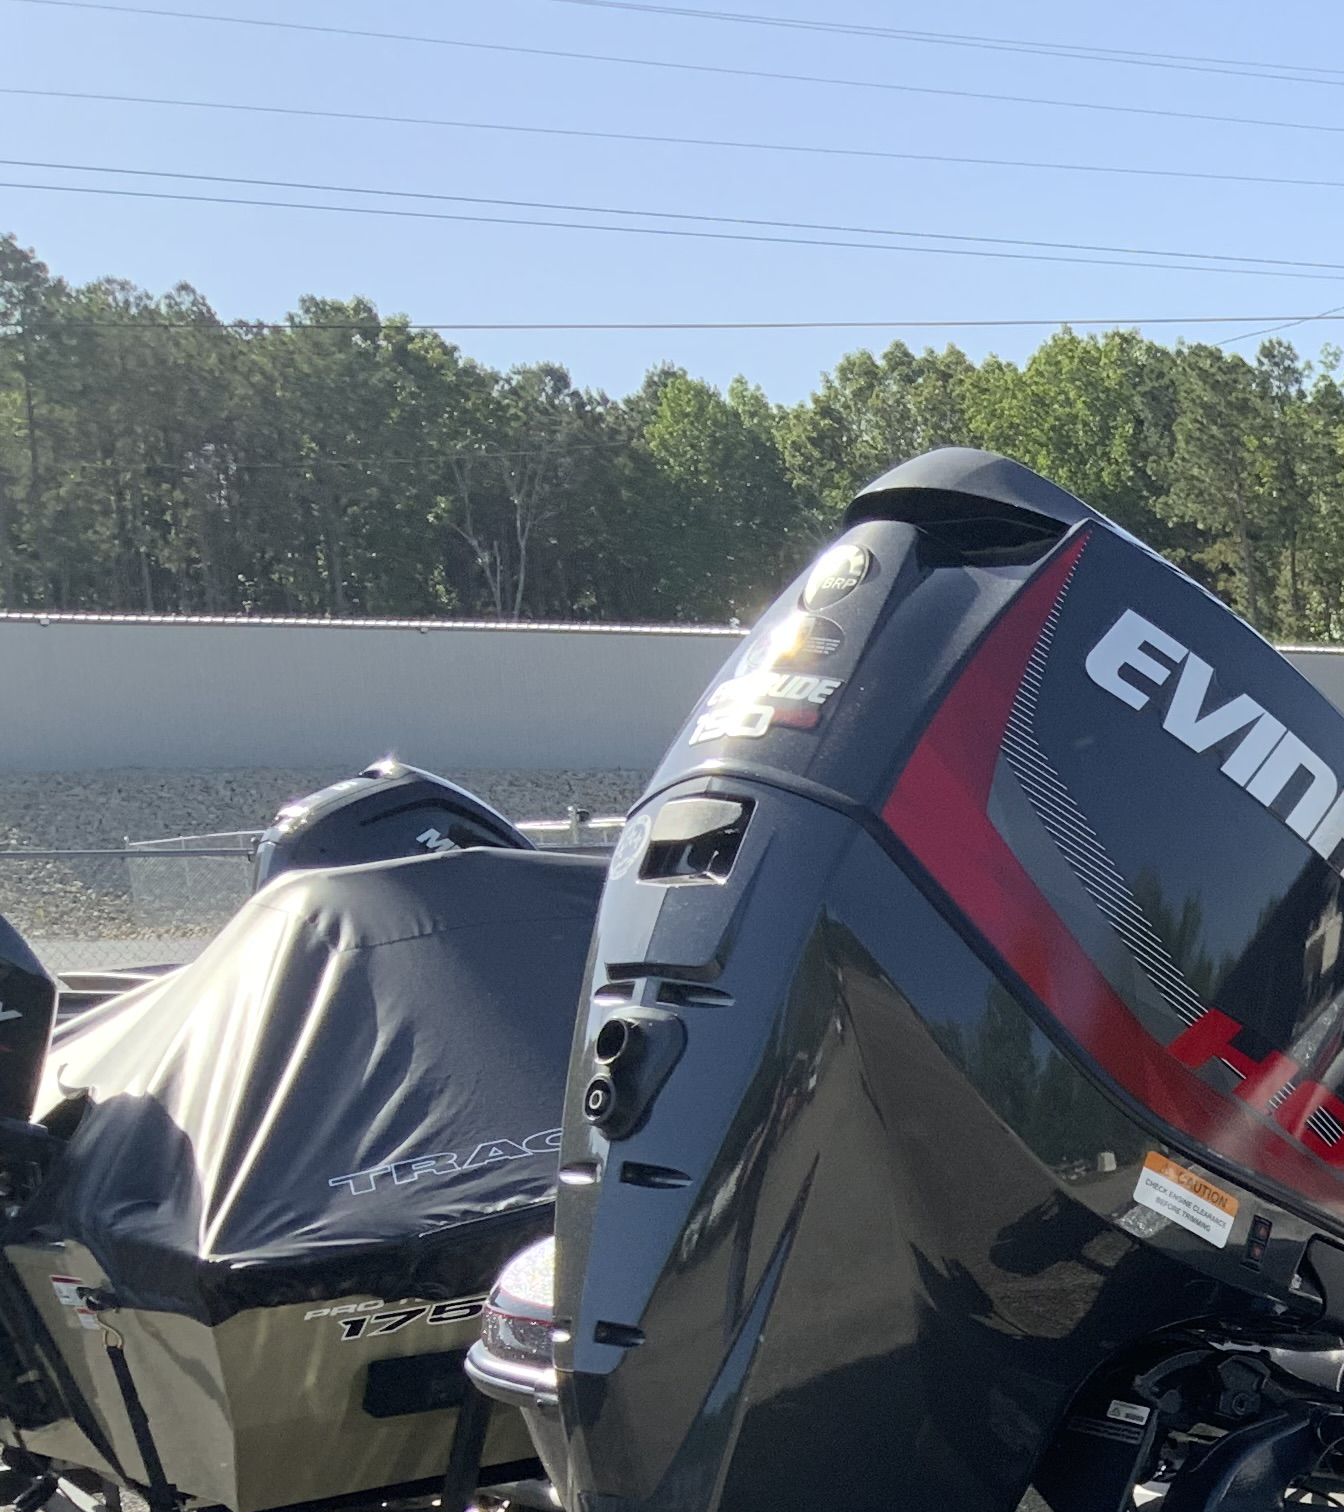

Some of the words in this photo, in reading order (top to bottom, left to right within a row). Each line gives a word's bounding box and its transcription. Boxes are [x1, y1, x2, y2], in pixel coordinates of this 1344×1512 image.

[821, 577, 858, 590] BRP
[328, 1127, 563, 1196] TRAC
[1178, 1170, 1229, 1209] CAUTION
[304, 1300, 385, 1321] PRO
[338, 1296, 488, 1342] 175
